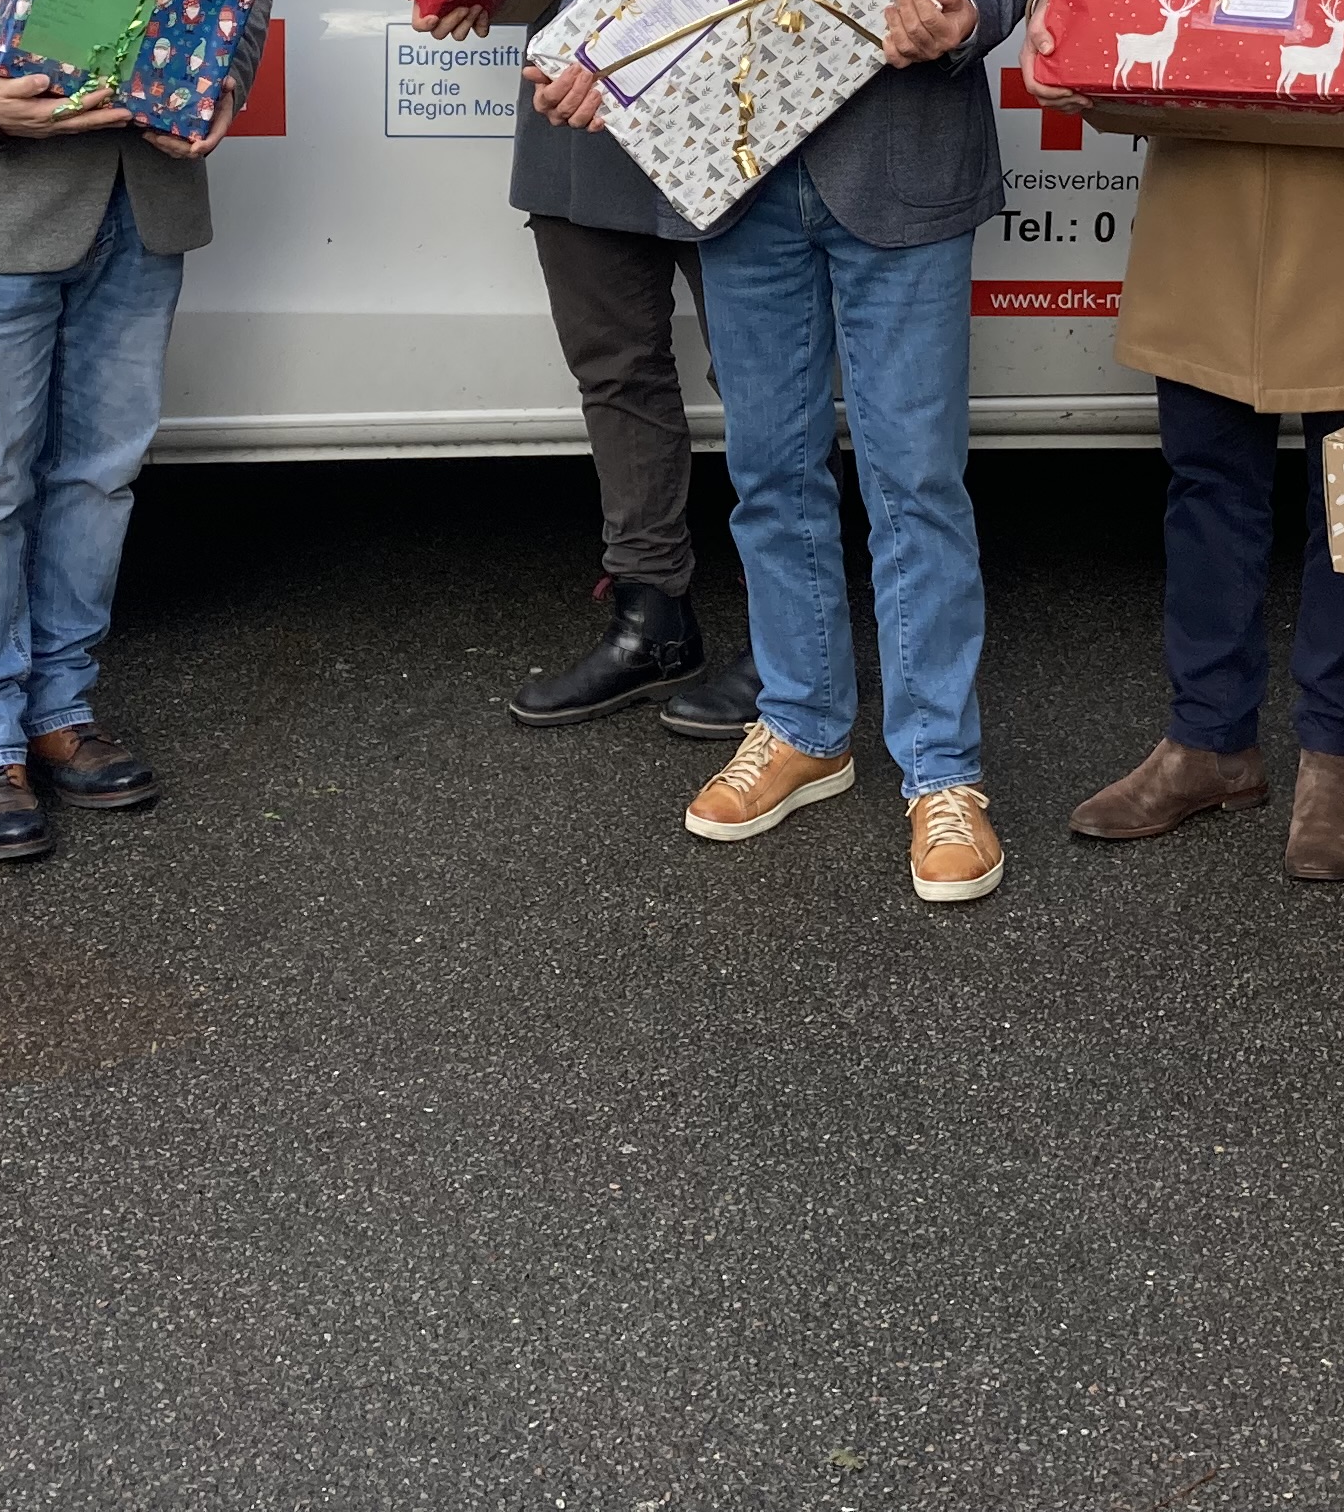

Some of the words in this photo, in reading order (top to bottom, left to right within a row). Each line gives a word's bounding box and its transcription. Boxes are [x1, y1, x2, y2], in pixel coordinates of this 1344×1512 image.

[398, 44, 523, 71] Bürgerstift
[398, 78, 425, 96] für
[431, 78, 460, 96] die
[398, 99, 467, 120] Region
[996, 210, 1077, 242] Tel.:
[1094, 211, 1116, 243] 0
